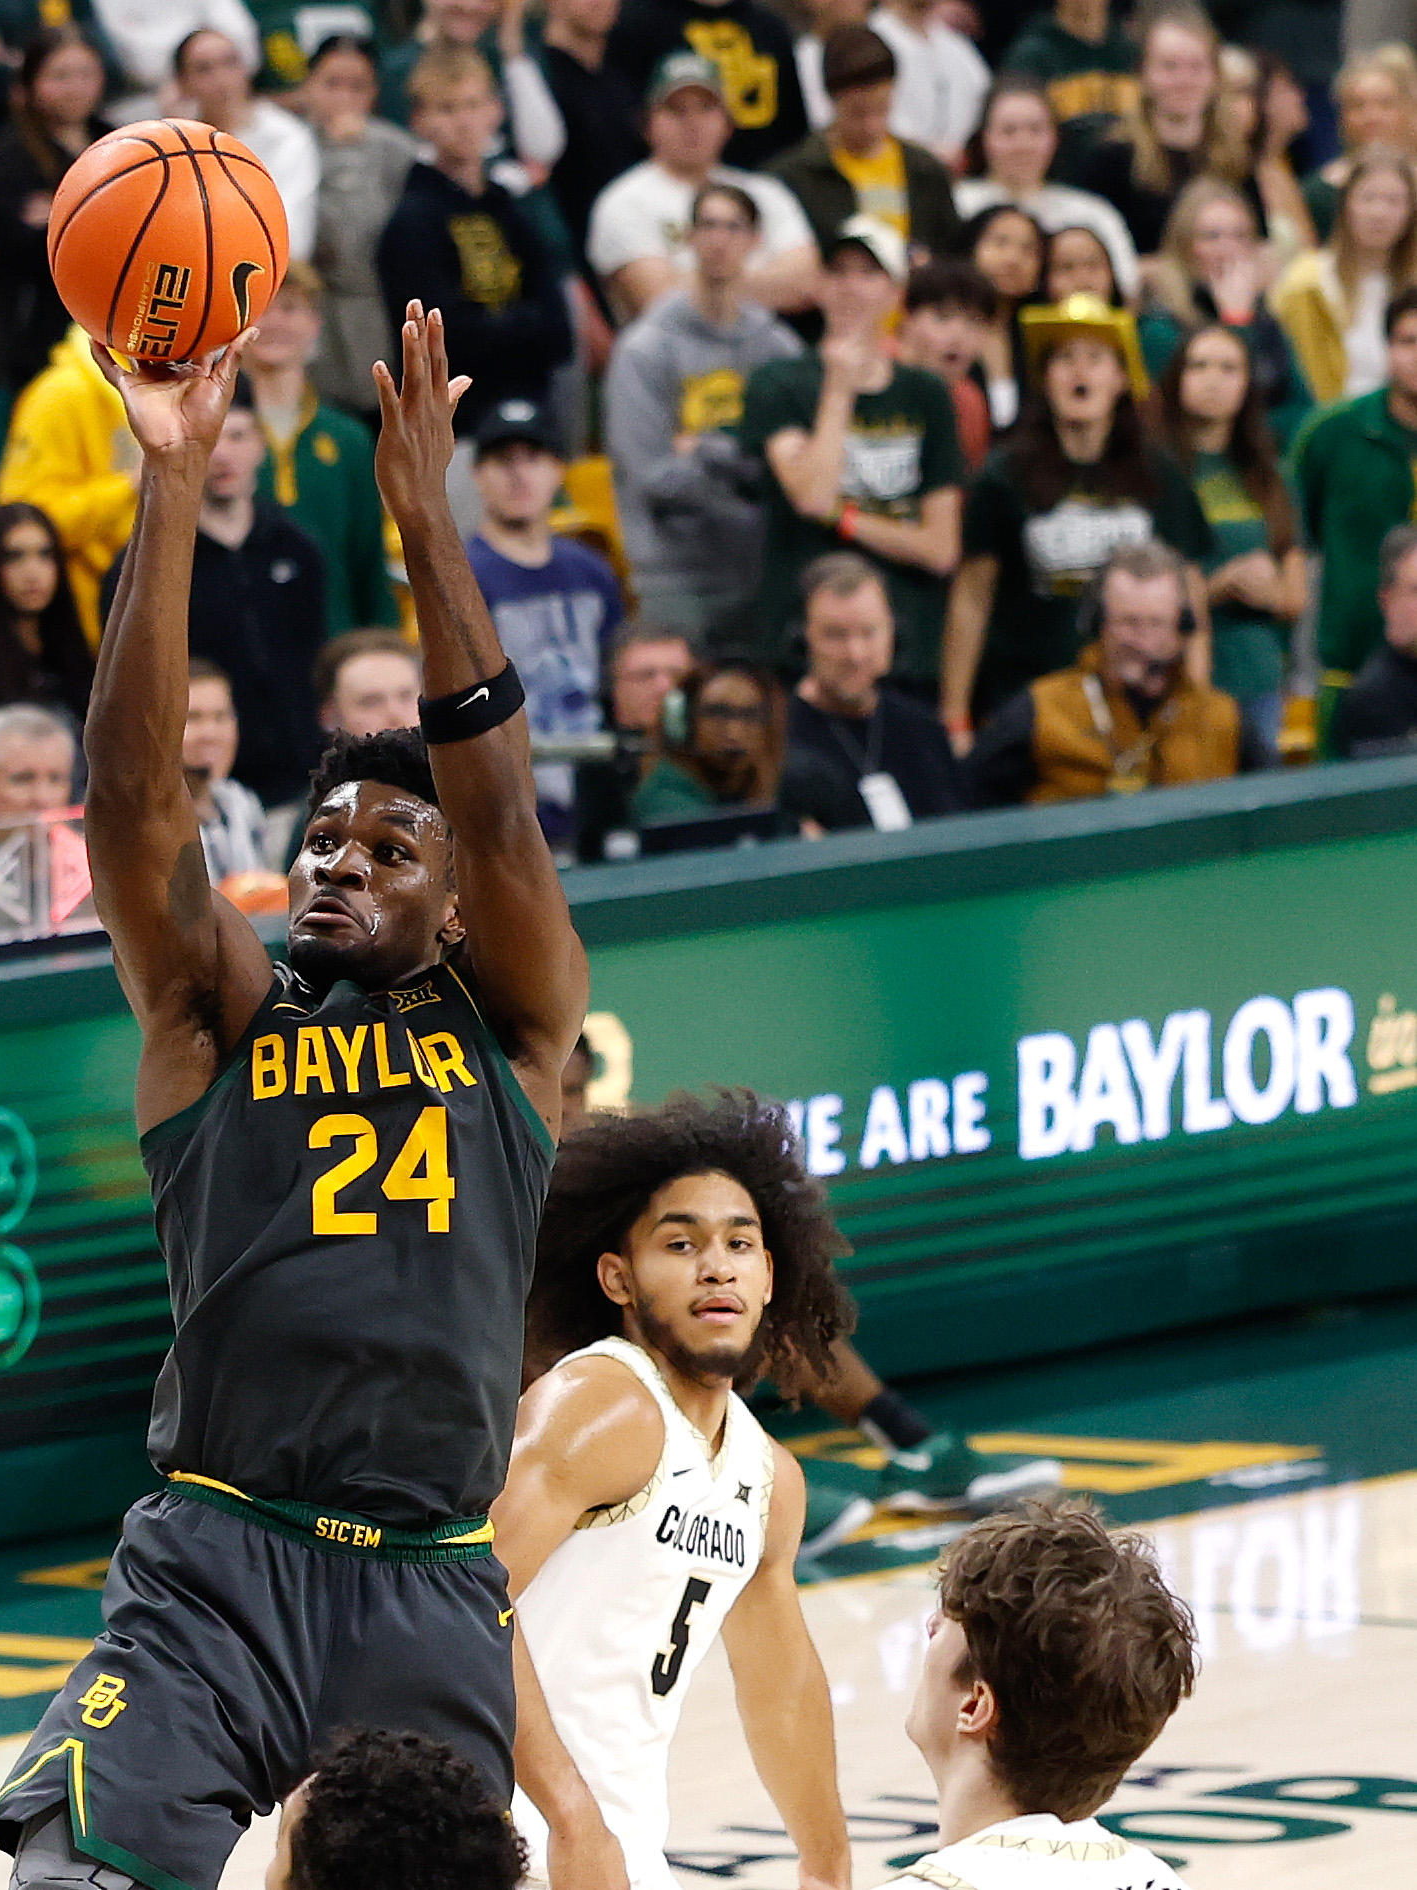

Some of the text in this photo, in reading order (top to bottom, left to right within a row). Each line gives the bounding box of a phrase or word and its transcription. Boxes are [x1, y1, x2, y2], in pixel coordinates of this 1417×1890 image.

[137, 261, 193, 358] ELITE
[251, 1021, 479, 1101] BAYLOR
[858, 1069, 994, 1169] ARE
[1015, 986, 1359, 1161] BAYLOR
[307, 1105, 457, 1236] 24
[655, 1504, 746, 1569] COLORADO
[650, 1572, 715, 1701] 5
[76, 1672, 128, 1730] BU
